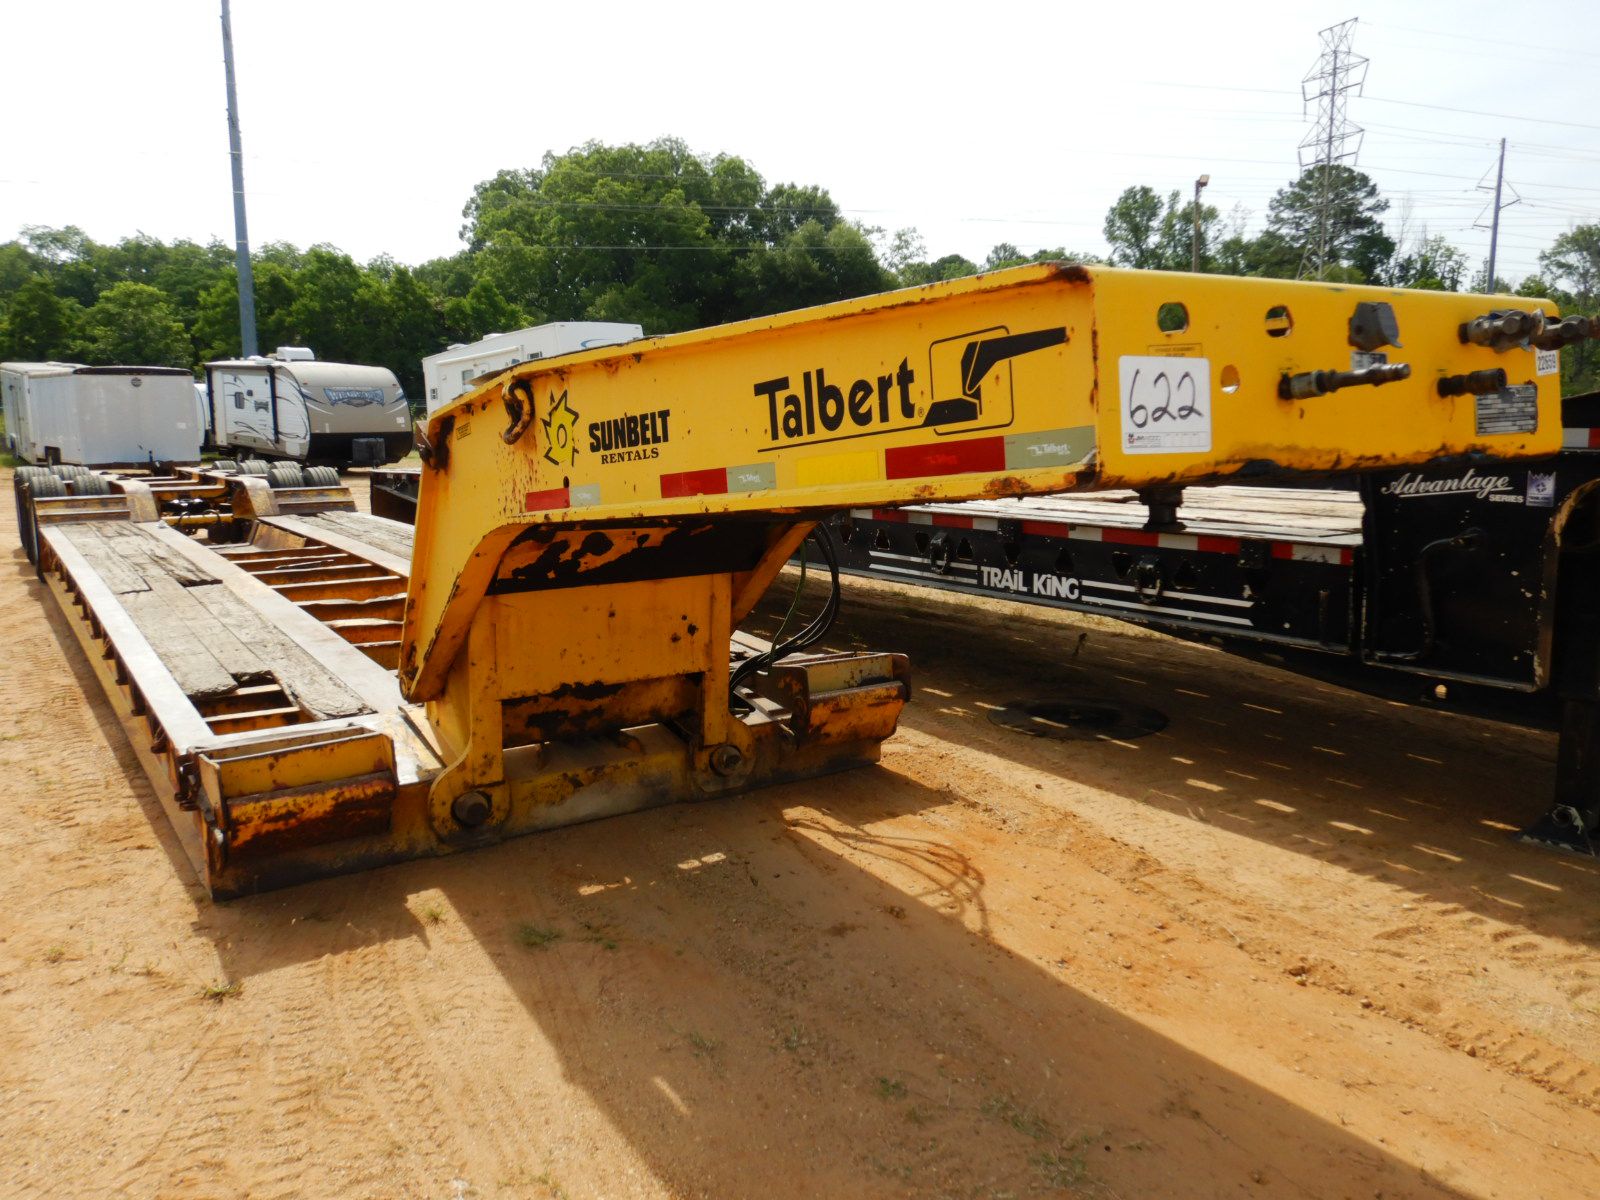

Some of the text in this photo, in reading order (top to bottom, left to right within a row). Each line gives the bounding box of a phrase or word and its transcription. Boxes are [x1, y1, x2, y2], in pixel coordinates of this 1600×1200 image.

[754, 356, 916, 441] Talbert
[1128, 368, 1204, 429] 622
[588, 409, 671, 453] SUNBELT
[601, 447, 660, 465] RENTALS
[1381, 468, 1511, 500] Advantage
[1489, 494, 1524, 504] SERIES
